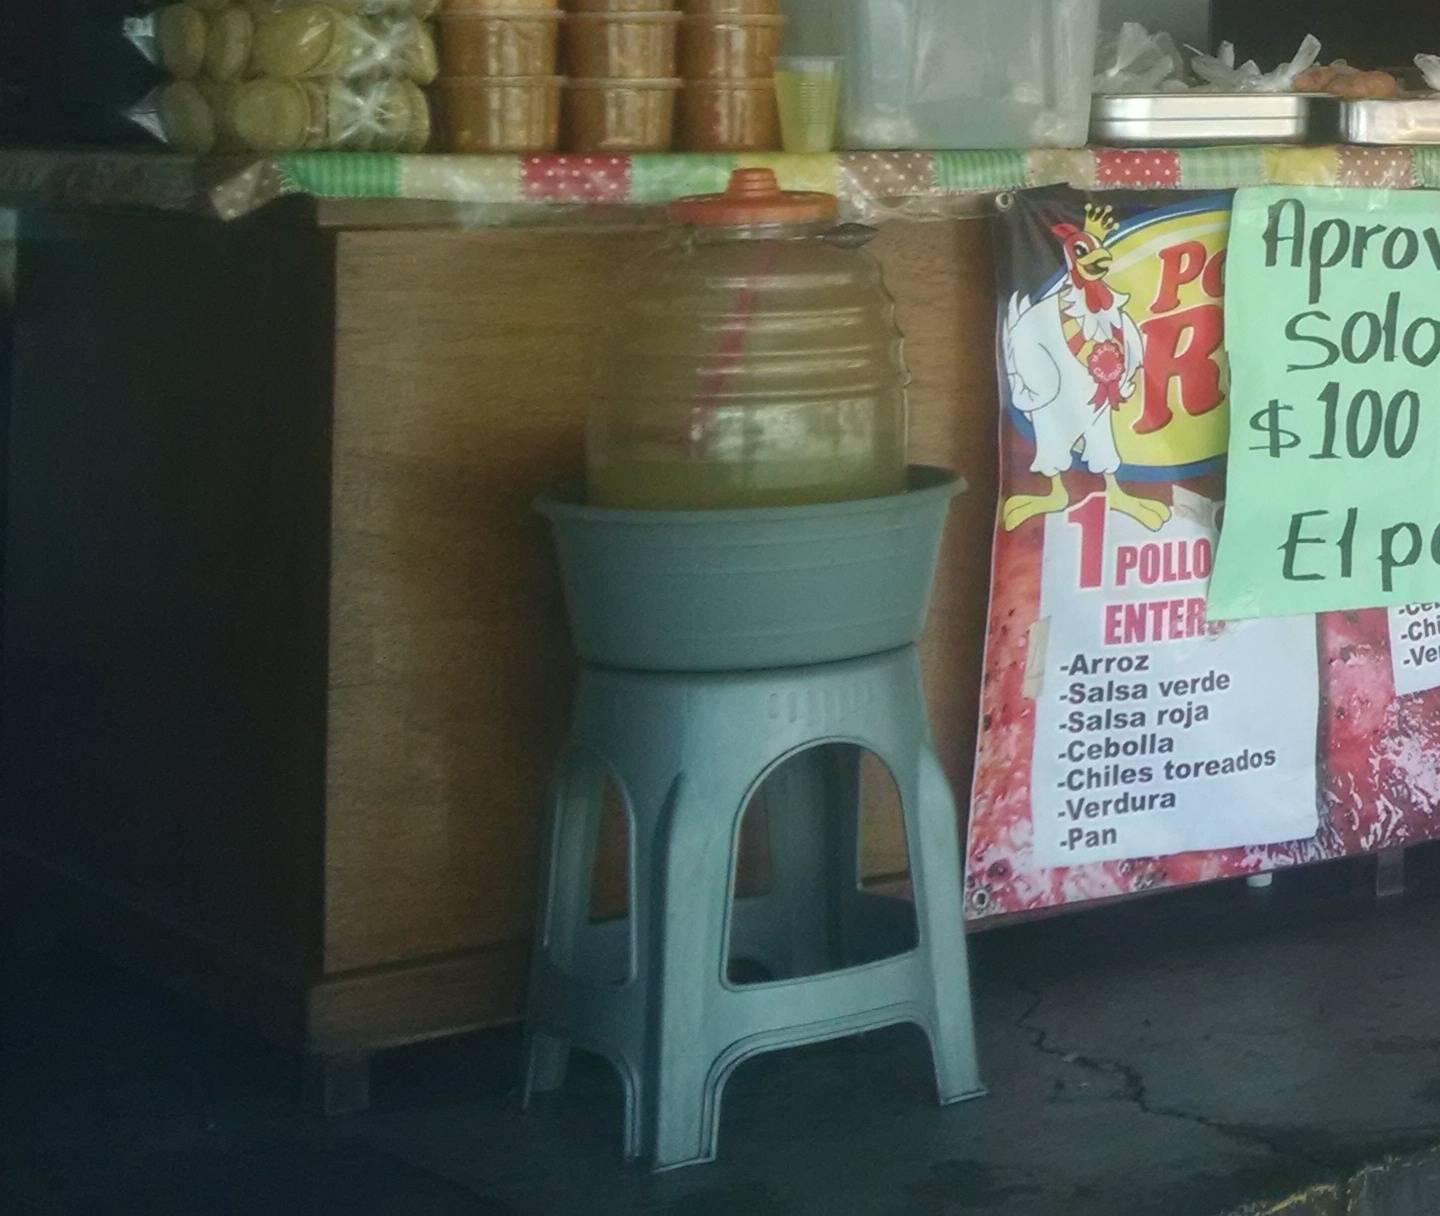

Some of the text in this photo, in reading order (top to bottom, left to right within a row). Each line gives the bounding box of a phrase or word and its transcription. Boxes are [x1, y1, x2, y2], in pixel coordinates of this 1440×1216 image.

[1249, 381, 1421, 460] $100
[1067, 495, 1212, 589] 1 POLLO
[1059, 654, 1150, 676] -Arroz
[1059, 670, 1231, 705] -Salsa verde
[1059, 701, 1209, 733] -Salsa roja
[1057, 733, 1175, 763] -Cebolla
[1056, 748, 1277, 791] -Chiles toreados
[1057, 792, 1176, 821] -Verdura
[1059, 827, 1118, 851] -Pan
